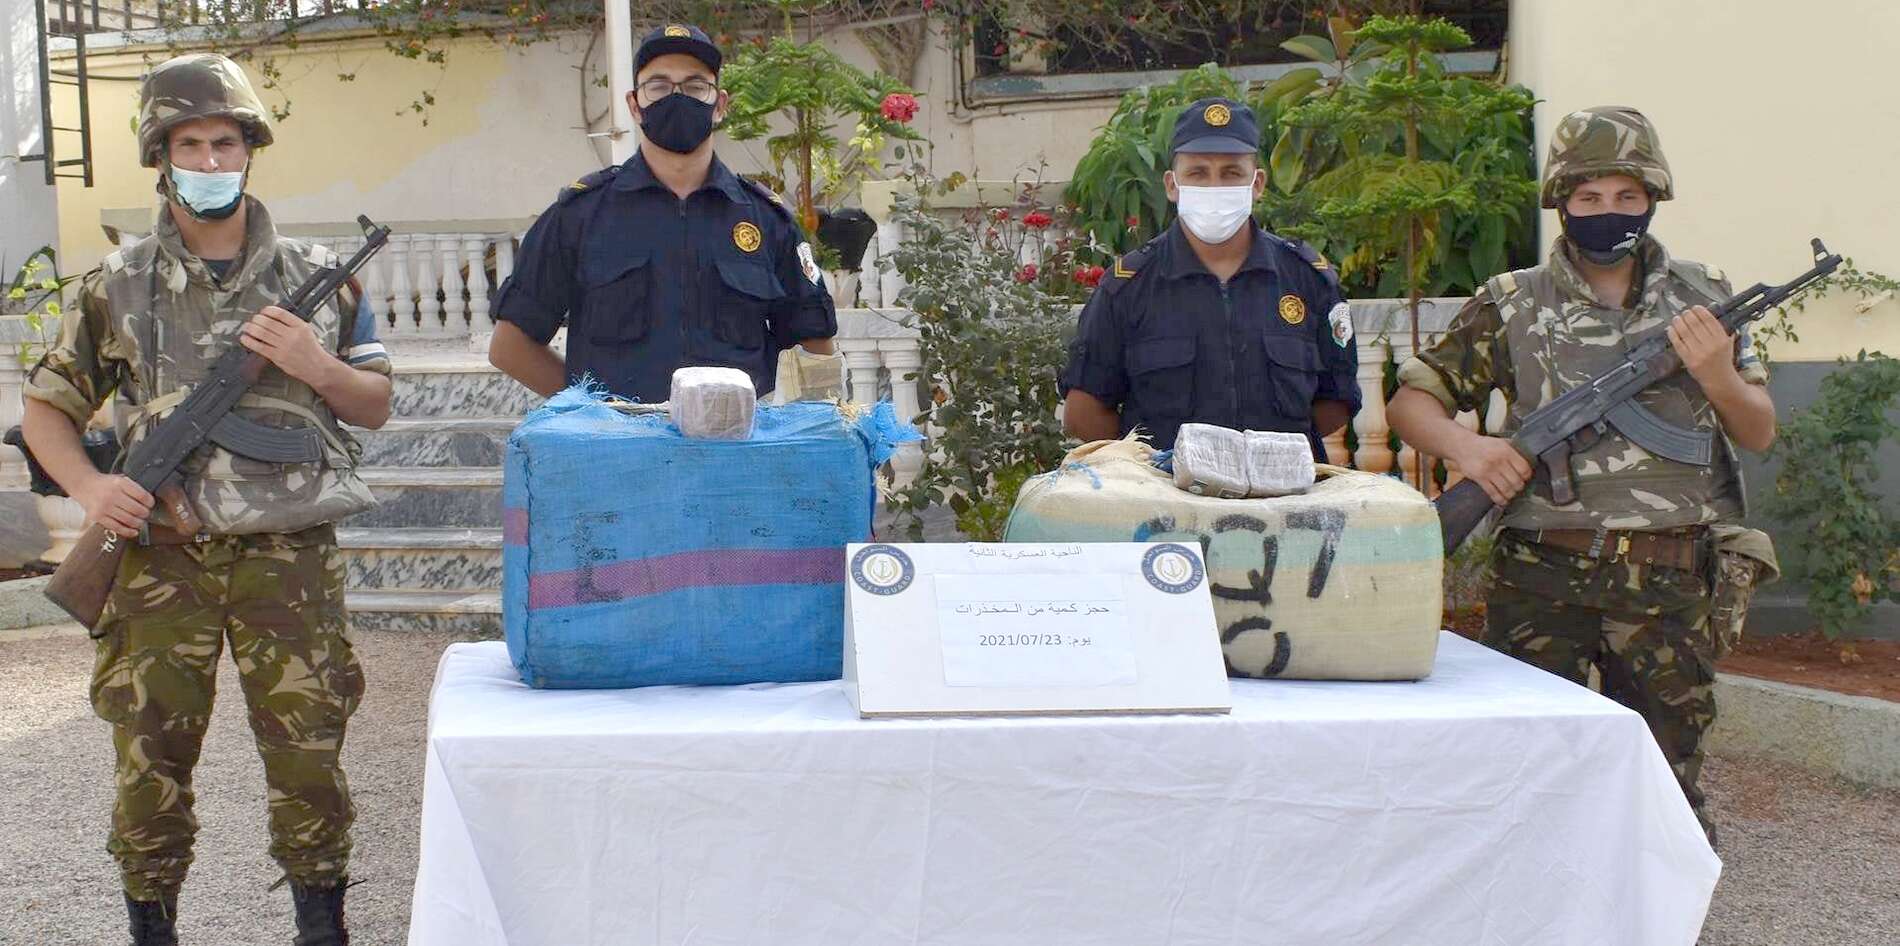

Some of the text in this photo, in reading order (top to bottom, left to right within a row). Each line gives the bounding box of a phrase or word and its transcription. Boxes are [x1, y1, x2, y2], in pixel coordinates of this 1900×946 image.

[968, 543, 1082, 560] الناحية العسكرية الثانية
[1027, 606, 1044, 616] من
[1048, 601, 1078, 614] كمية
[1084, 602, 1110, 616] حجز
[979, 634, 1062, 647] 2021/07/23
